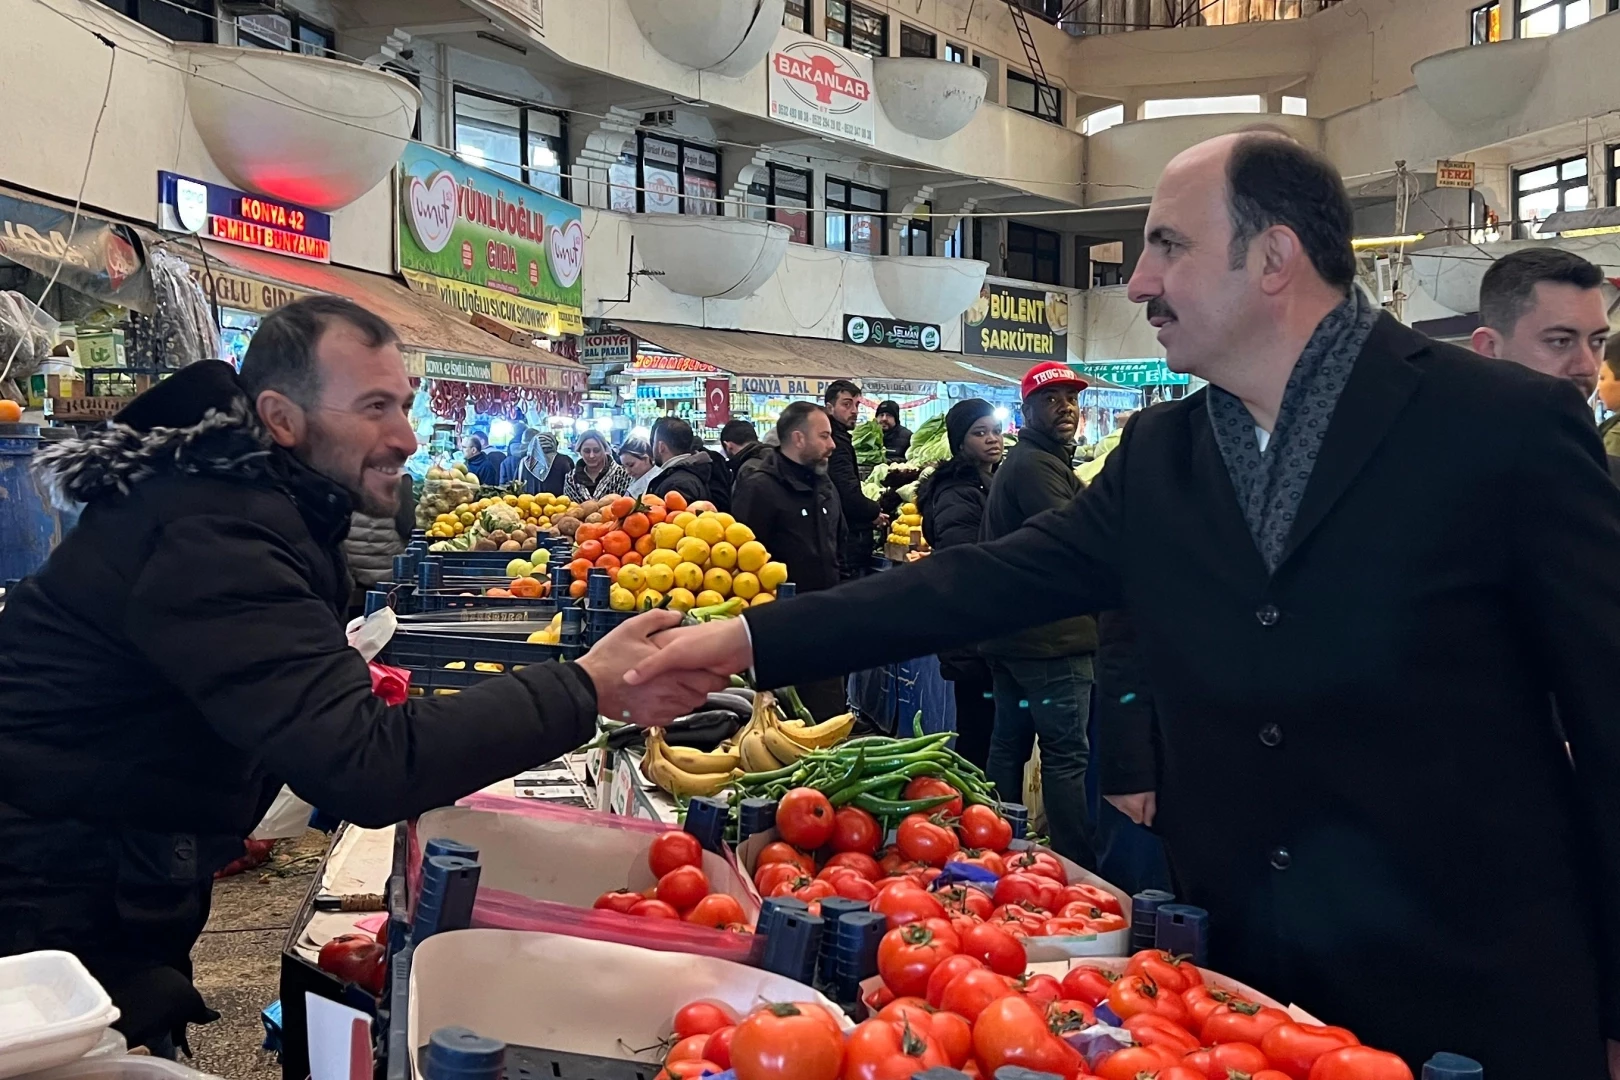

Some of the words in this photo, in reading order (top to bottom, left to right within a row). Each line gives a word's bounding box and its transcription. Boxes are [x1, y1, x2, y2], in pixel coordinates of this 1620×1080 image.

[779, 57, 865, 98] BAKANLAR
[1440, 168, 1472, 180] TERZİ
[241, 196, 286, 227] KONYA
[288, 210, 305, 231] 42
[456, 177, 545, 245] YÜNLÜOĞLU
[213, 216, 262, 246] İSMİLLİ
[263, 227, 327, 259] BÜNYAMİN
[486, 238, 518, 274] GIDA
[990, 290, 1045, 325] BÜLENT
[584, 348, 599, 357] BAL
[601, 347, 629, 356] PAZARI
[585, 335, 628, 346] KONYA
[981, 328, 1053, 354] ŞARKÜTERİ
[506, 364, 547, 386] YALÇIN
[741, 378, 780, 393] KONYA
[788, 380, 810, 394] BAL
[1033, 369, 1059, 385] THUG
